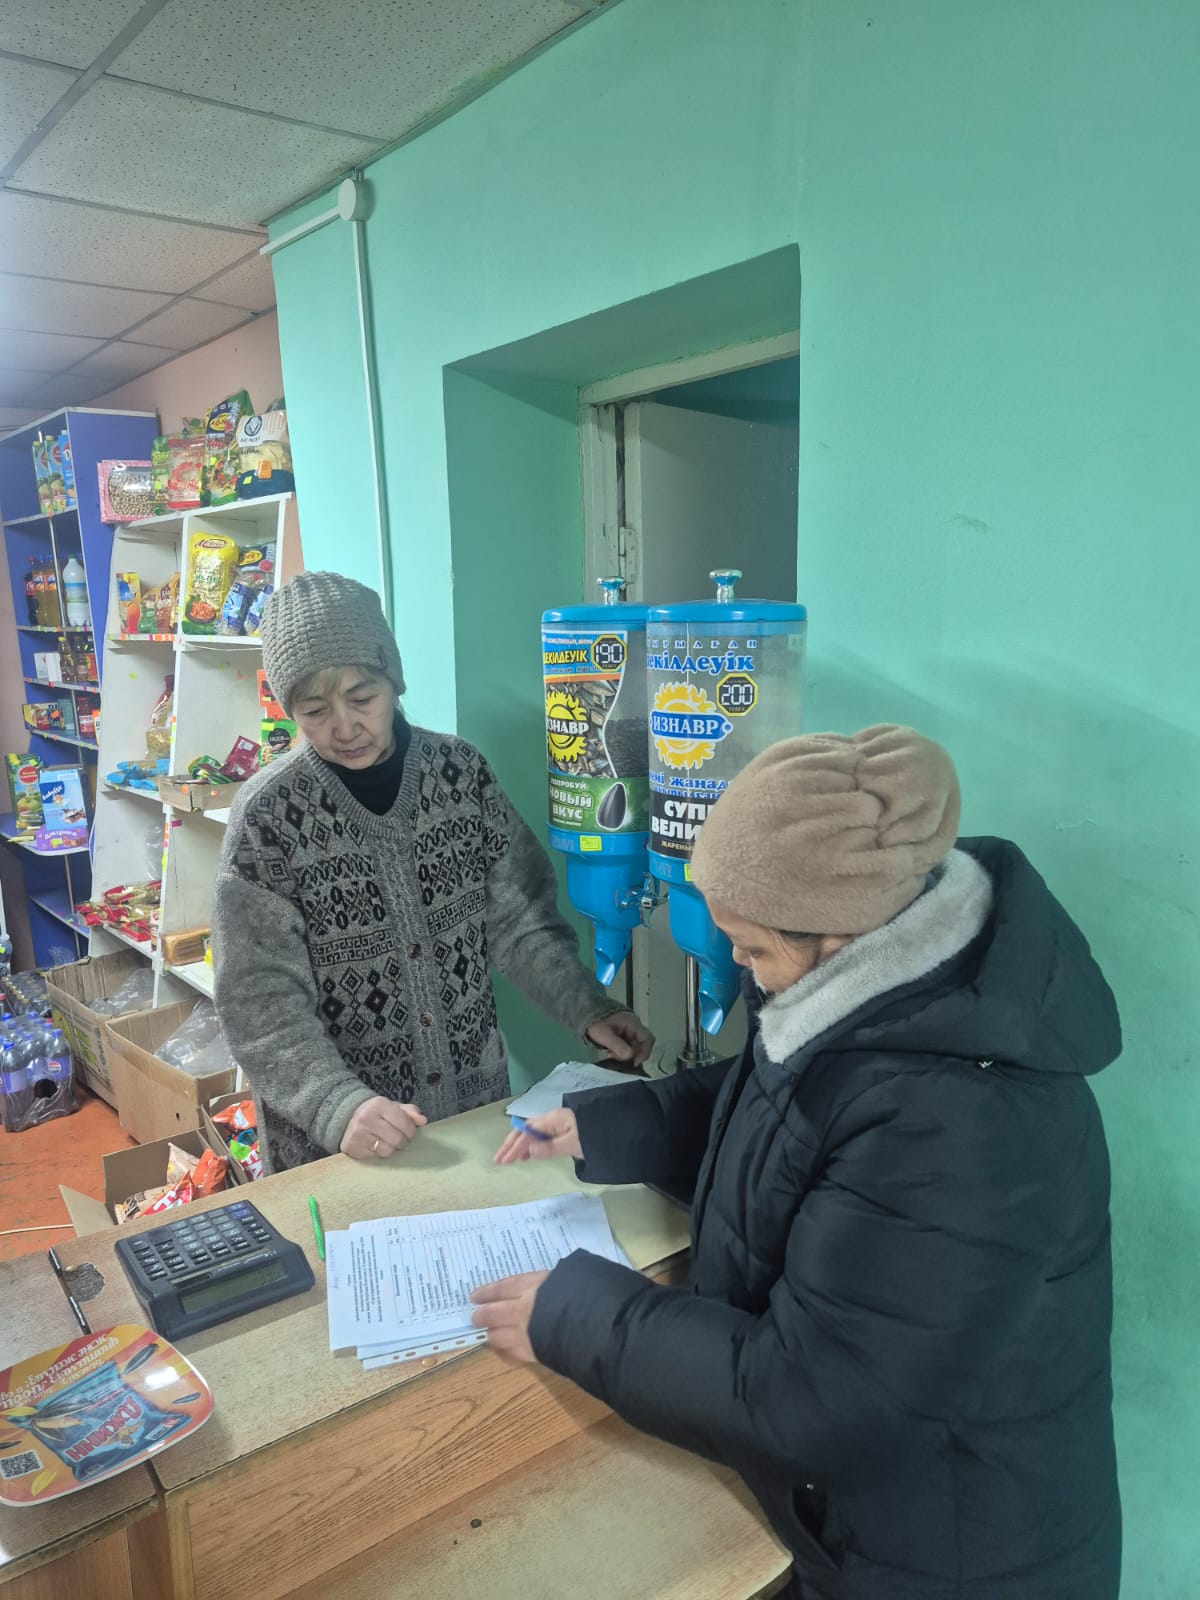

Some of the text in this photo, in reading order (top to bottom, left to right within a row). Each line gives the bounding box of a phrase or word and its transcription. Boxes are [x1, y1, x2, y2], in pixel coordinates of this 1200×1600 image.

[595, 643, 623, 664] 190
[721, 683, 754, 706] 200
[652, 715, 719, 735] ИЗНАВР
[549, 786, 592, 808] НОВЫЙ
[553, 804, 583, 820] ВКУС
[651, 816, 703, 840] ВЕЛИ
[65, 1395, 142, 1461] ДЖИНН
